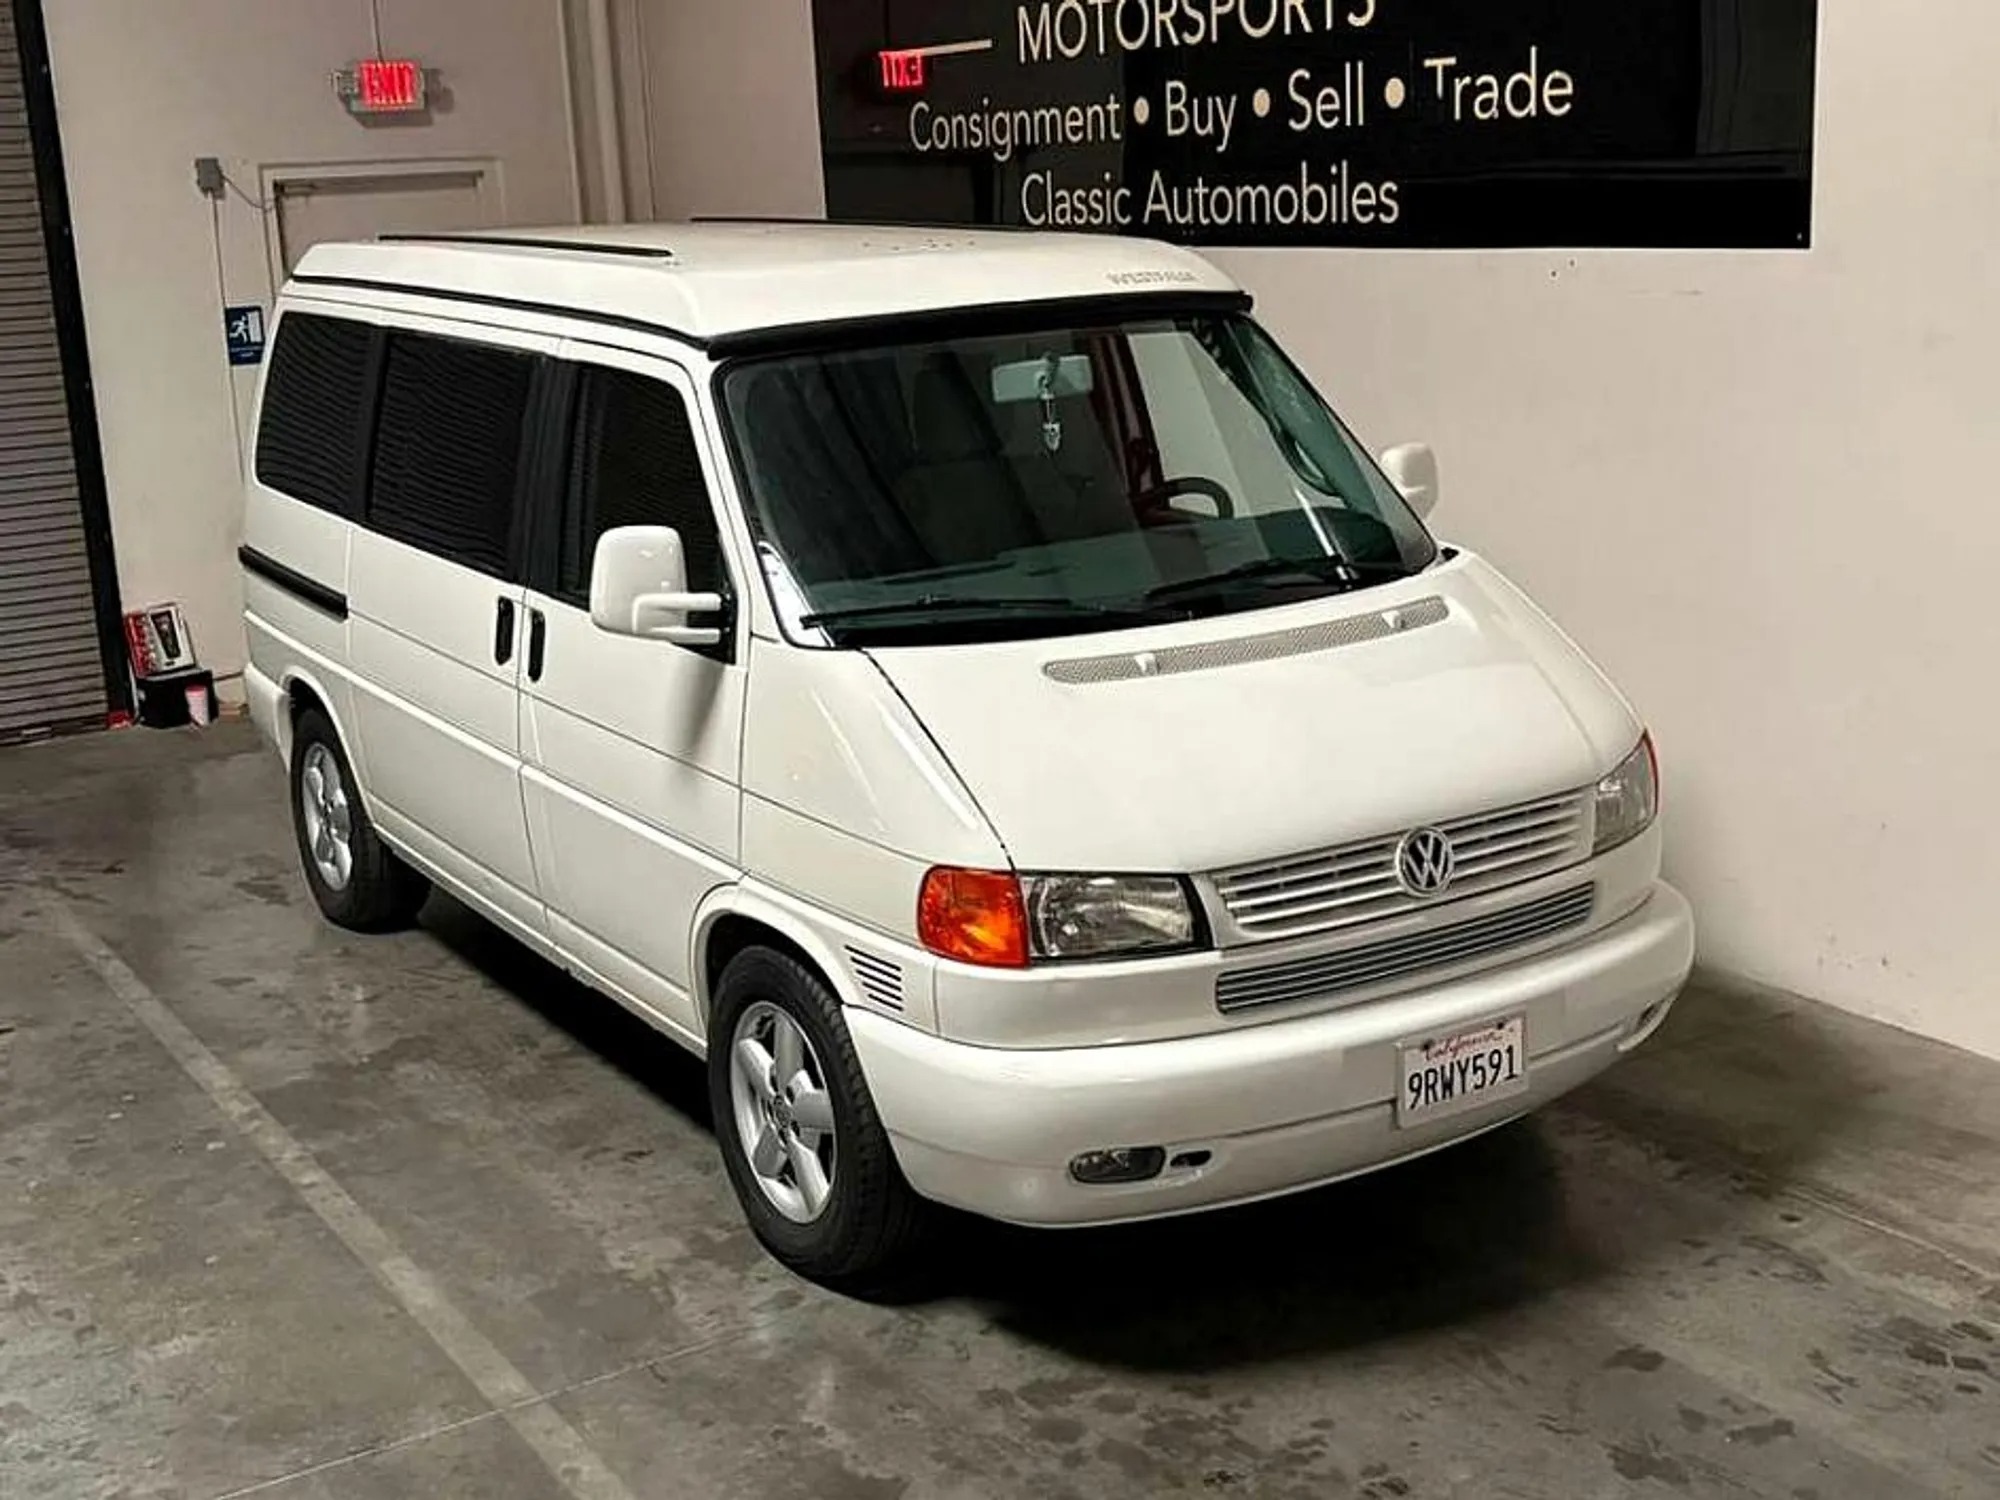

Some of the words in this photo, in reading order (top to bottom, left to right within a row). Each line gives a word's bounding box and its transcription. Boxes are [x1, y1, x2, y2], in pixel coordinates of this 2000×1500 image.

[362, 61, 414, 105] EXIT
[909, 96, 1121, 162] Consignment
[1165, 80, 1237, 152] Buy
[1288, 61, 1364, 131] Sell
[1423, 45, 1574, 120] Trade
[1022, 172, 1133, 226] Classic
[1143, 160, 1399, 225] Automobiles
[1400, 829, 1451, 892] VW
[1408, 1044, 1519, 1110] 9RWY591
